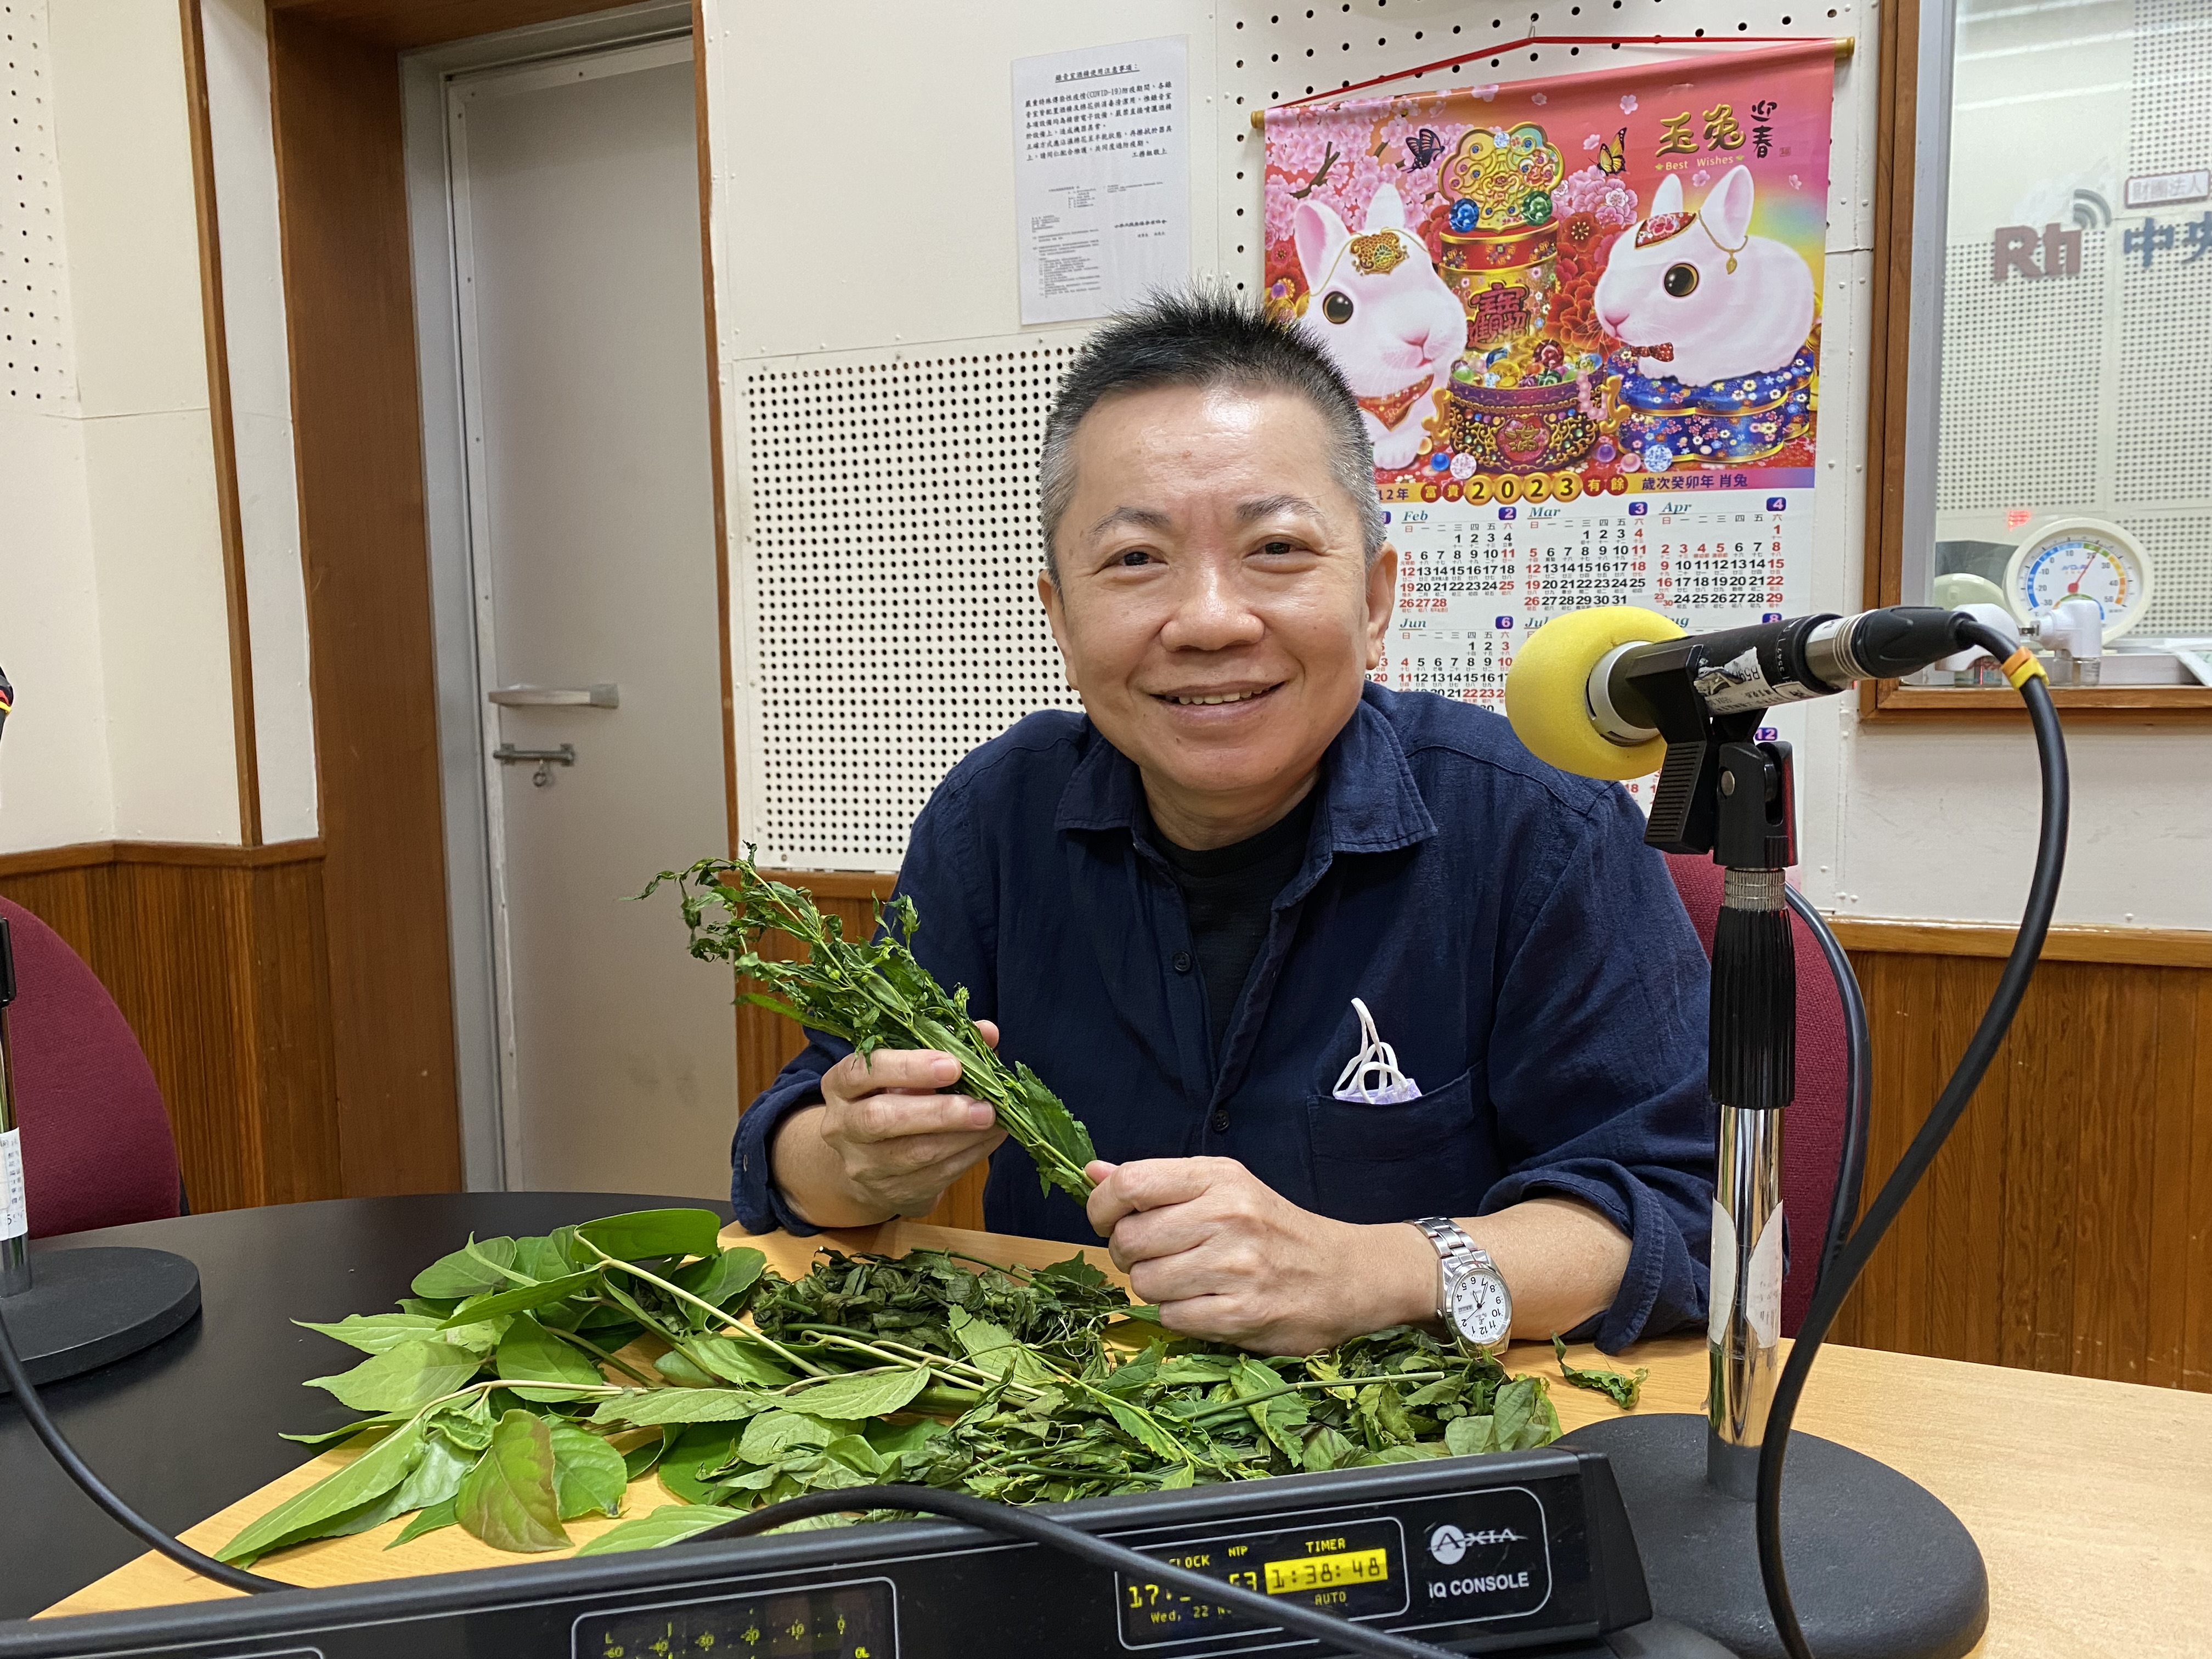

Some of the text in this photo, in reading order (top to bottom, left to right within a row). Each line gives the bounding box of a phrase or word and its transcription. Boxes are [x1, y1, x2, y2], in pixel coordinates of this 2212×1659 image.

[1655, 103, 1746, 158] 玉兔
[1751, 100, 1778, 159] 迎春
[1666, 156, 1734, 171] Best Wishes
[1425, 484, 1459, 498] 富貴
[1588, 477, 1624, 492] 有餘
[1635, 503, 1645, 515] 3
[1662, 501, 1692, 514] Apr
[1773, 498, 1783, 510] 4
[1403, 510, 1429, 522] Feb
[1504, 508, 1514, 520] 2
[1528, 506, 1561, 518] Mar
[1583, 528, 1643, 539] 1 2 3 4
[1774, 525, 1780, 534] 1
[1455, 533, 1512, 543] 1 2 3 4
[1530, 545, 1646, 557] 5 6 7 8 9 10 11
[1661, 541, 1780, 554] 2 3 4 5 6 7 8
[1404, 549, 1514, 561] 5 6 7 8 9 10 11
[1401, 565, 1515, 576] 12 13 14 15 16 17 18
[1526, 562, 1646, 573] 12 13 14 15 16 17 18
[1661, 559, 1784, 571] 9 10 11 12 13 14 15
[1400, 581, 1514, 592] 19 20 21 22 23 24 25
[1525, 578, 1645, 589] 19 20 21 22 23 24 25
[1400, 598, 1447, 608] 26 27 28
[1524, 595, 1627, 606] 26 27 28 29 30 31
[1400, 618, 1427, 628] Jun
[1501, 617, 1511, 628] 6
[1757, 729, 1776, 740] 12
[1462, 1282, 1468, 1291] 5
[1489, 1285, 1496, 1293] 8
[1456, 1294, 1463, 1302] 4
[1496, 1296, 1502, 1305] 9
[1492, 1308, 1502, 1317] 10
[1461, 1319, 1468, 1328] 2
[1489, 1319, 1497, 1329] 11
[1480, 1327, 1489, 1335] 12
[1305, 1537, 1346, 1554] TIMER
[1228, 1545, 1249, 1558] NTP
[1428, 1571, 1530, 1599] IQ CONSOLE
[1314, 1591, 1347, 1606] AUTO
[1193, 1605, 1209, 1619] 22
